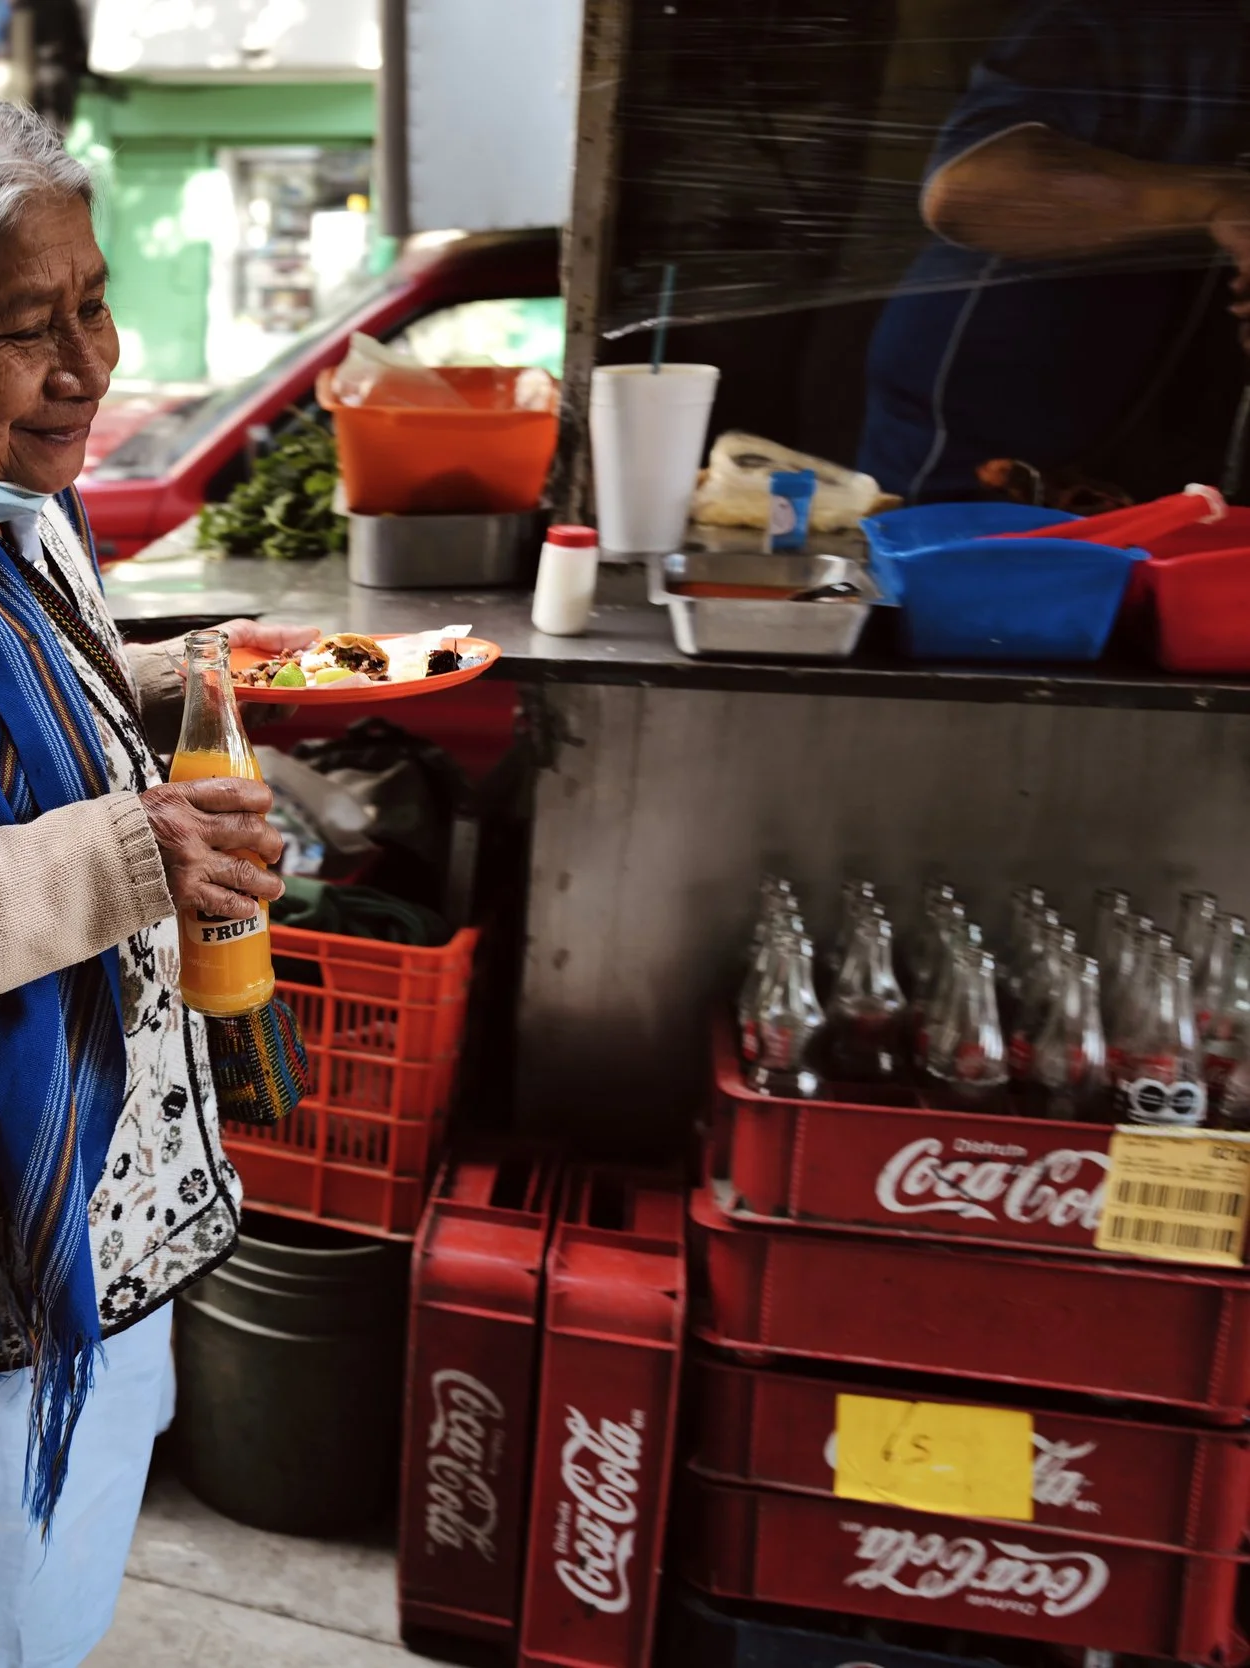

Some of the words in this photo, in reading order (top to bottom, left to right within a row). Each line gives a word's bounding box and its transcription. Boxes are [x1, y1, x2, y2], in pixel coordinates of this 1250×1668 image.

[201, 916, 258, 942] FRUT
[875, 1137, 1112, 1231] Coca-Col
[554, 1404, 643, 1615] Coca-Cola
